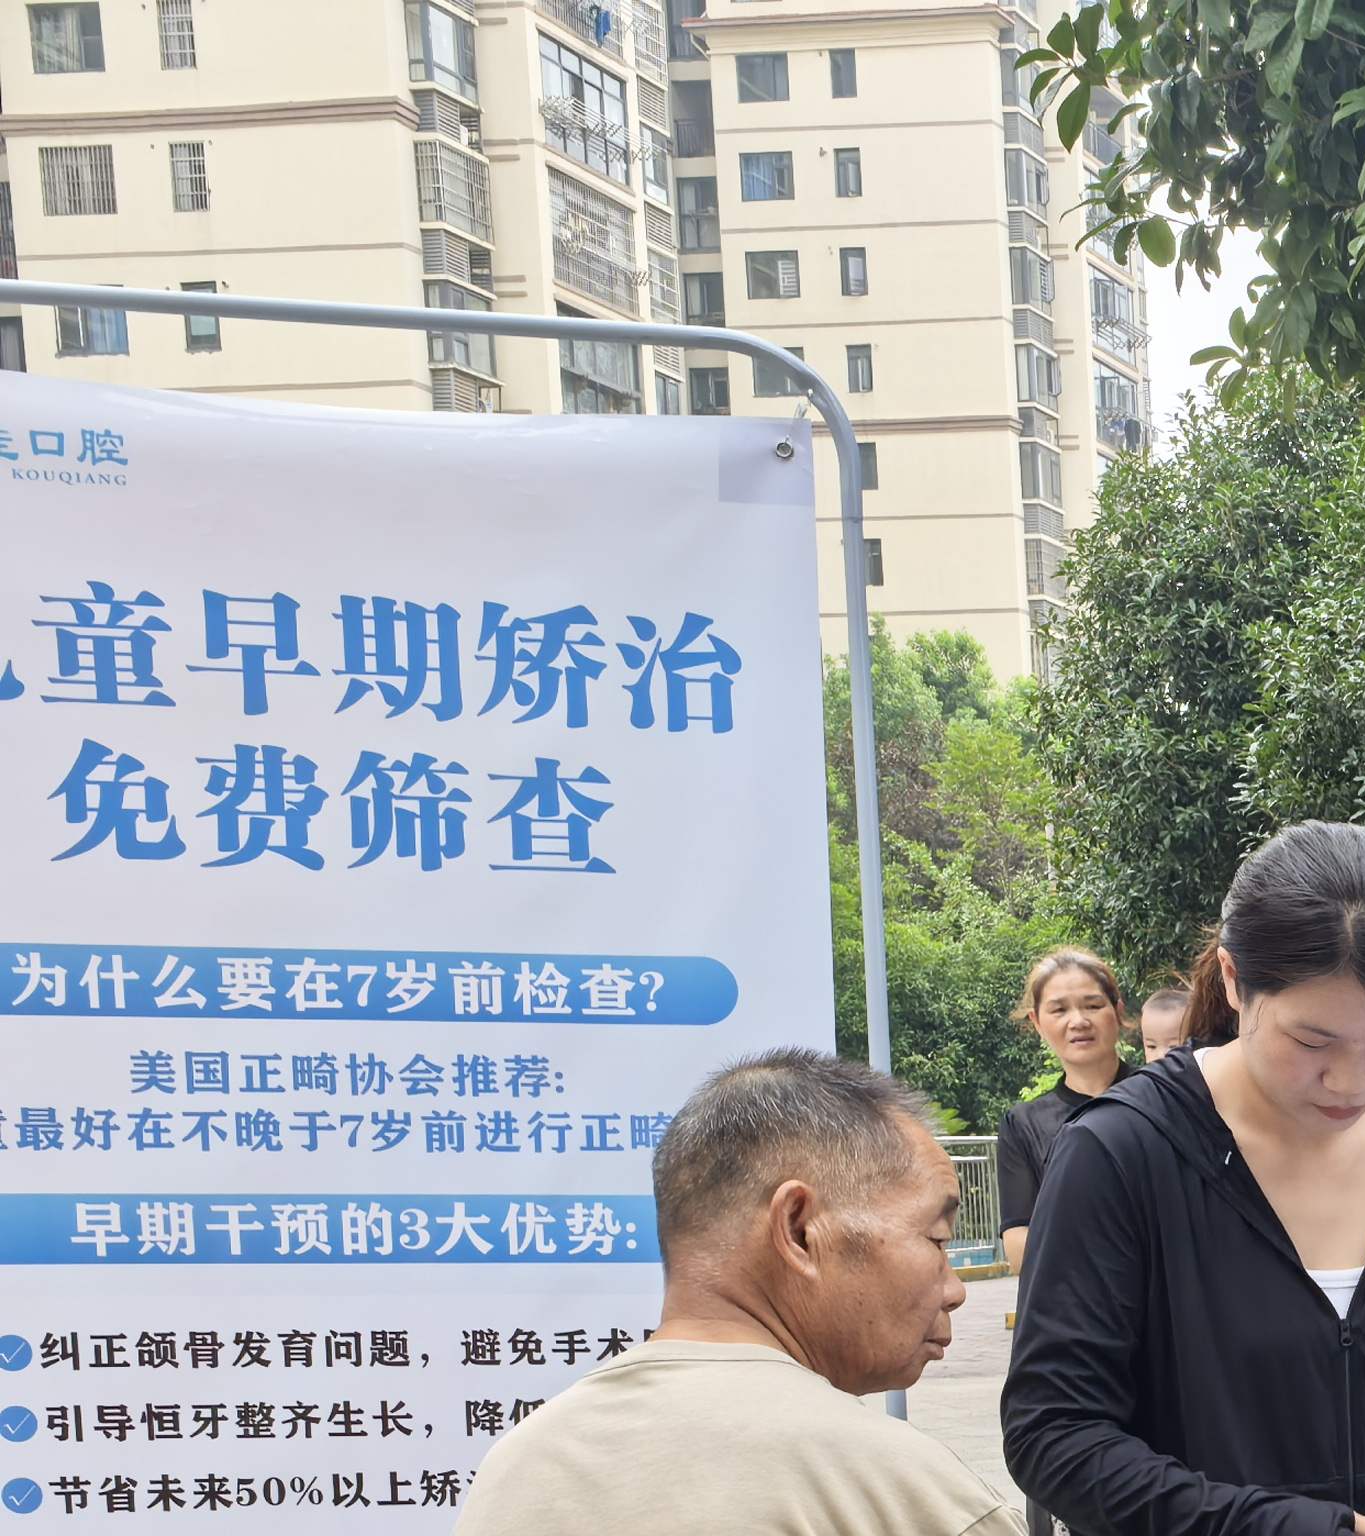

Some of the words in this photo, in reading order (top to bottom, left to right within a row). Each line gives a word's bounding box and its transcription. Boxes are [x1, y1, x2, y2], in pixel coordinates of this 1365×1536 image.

[12, 468, 127, 487] KOUQIANG
[0, 581, 742, 734] 童早期矫治
[47, 738, 618, 875] 免费筛查
[10, 952, 666, 1018] 为什么要在7岁前检查?
[129, 1049, 566, 1096] 美国正畸协会推荐:
[0, 1107, 672, 1153] 最好在不晚于7岁前进行正畸
[70, 1201, 638, 1258] 早期干预的3大优势:
[40, 1328, 655, 1370] 纠正颌骨发育问题，避免手术
[49, 1469, 478, 1513] 节省未来50%以上矫
